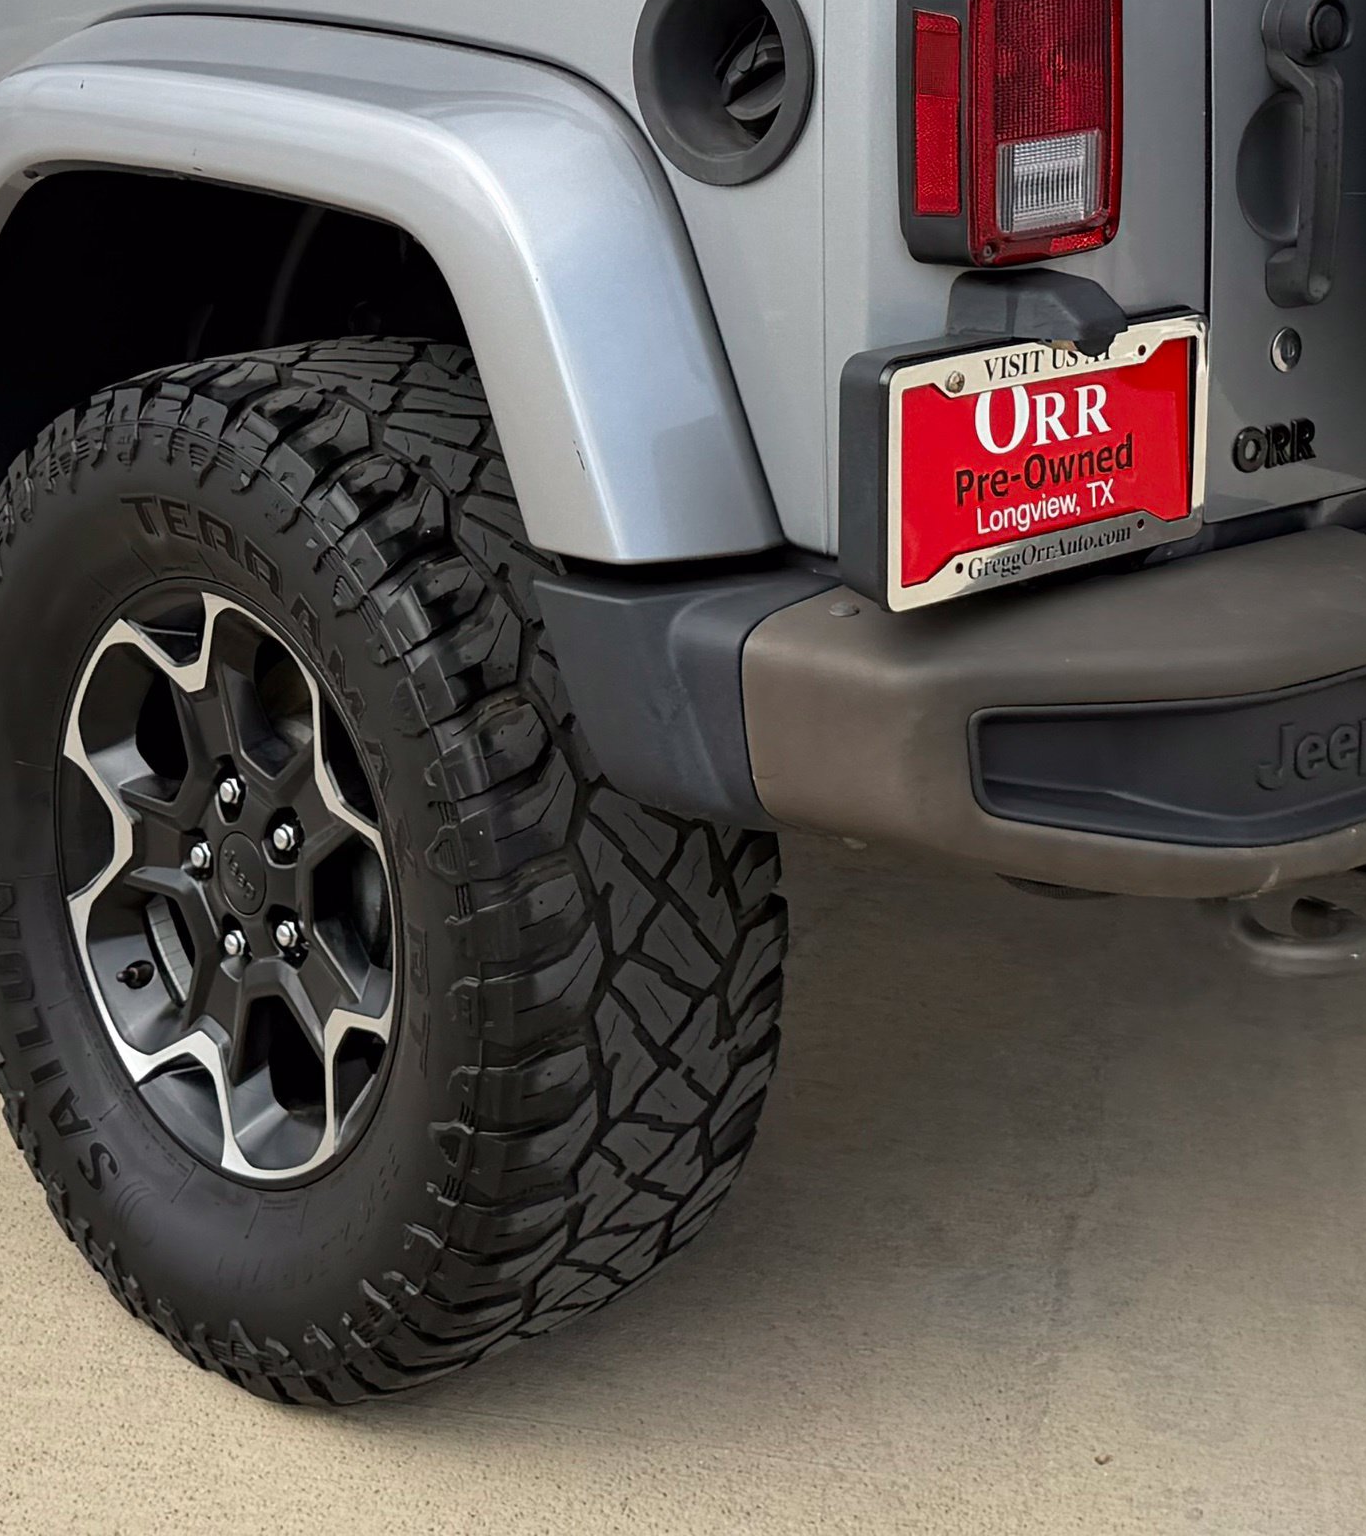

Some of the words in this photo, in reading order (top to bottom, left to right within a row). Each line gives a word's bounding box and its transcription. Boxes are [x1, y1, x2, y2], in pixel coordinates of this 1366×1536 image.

[983, 349, 1045, 382] VISIT
[955, 432, 1134, 507] Pre-Owned
[1232, 417, 1317, 474] ORR
[976, 490, 1081, 535] Longview,
[1086, 478, 1115, 507] TX
[967, 524, 1132, 581] GreggOrrAuto.com
